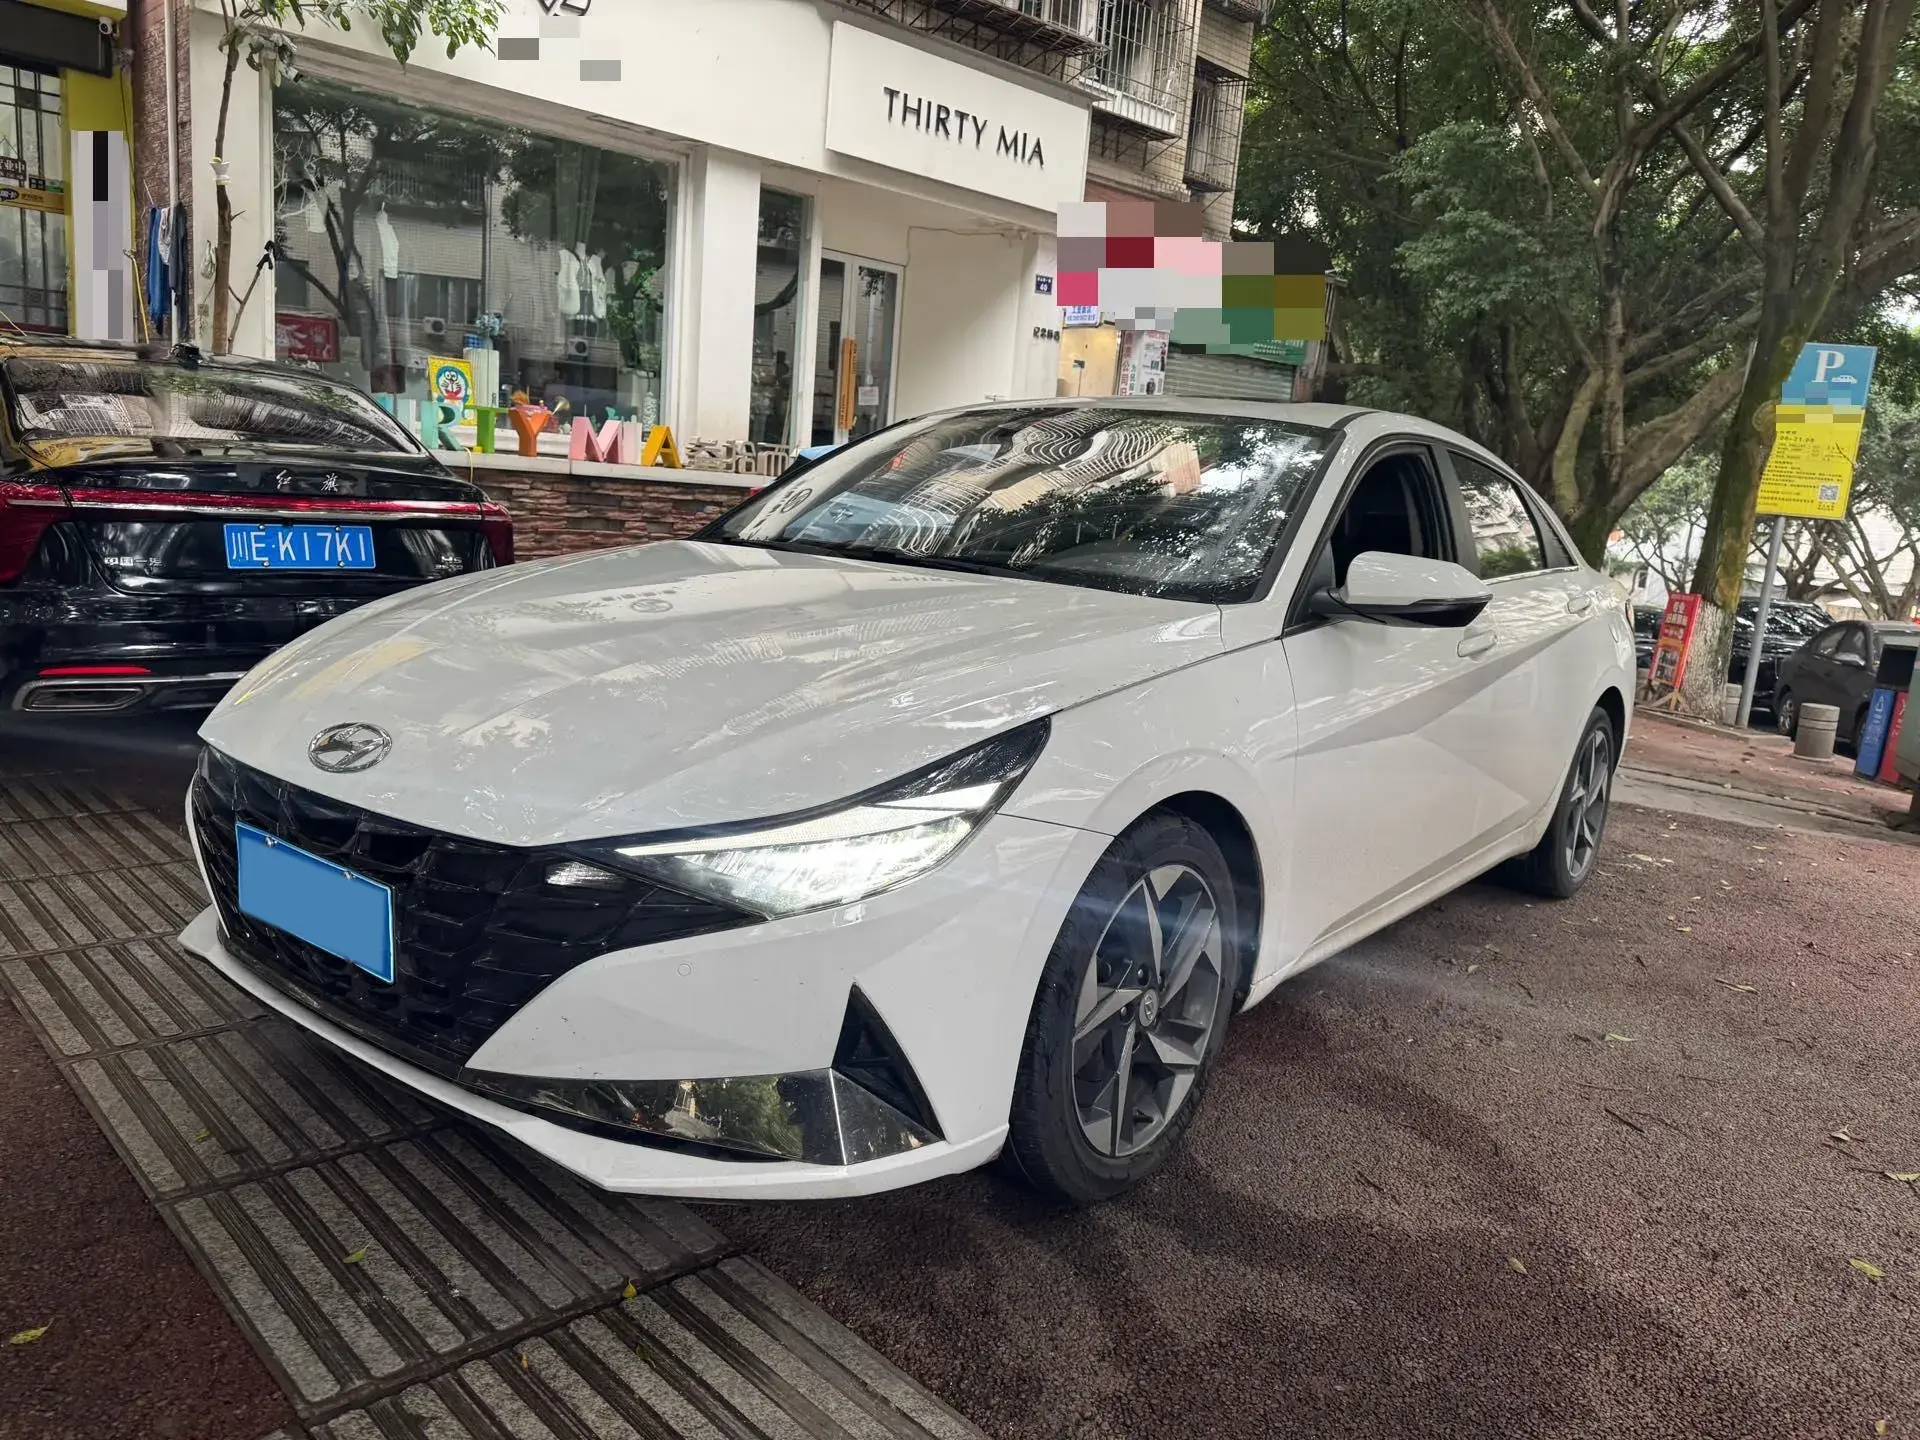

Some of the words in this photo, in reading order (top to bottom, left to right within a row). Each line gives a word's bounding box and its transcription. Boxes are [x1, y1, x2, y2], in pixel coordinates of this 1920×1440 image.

[884, 86, 988, 148] THIRTY
[996, 124, 1045, 168] MIA
[1811, 349, 1845, 383] P
[276, 469, 339, 493] 红旗
